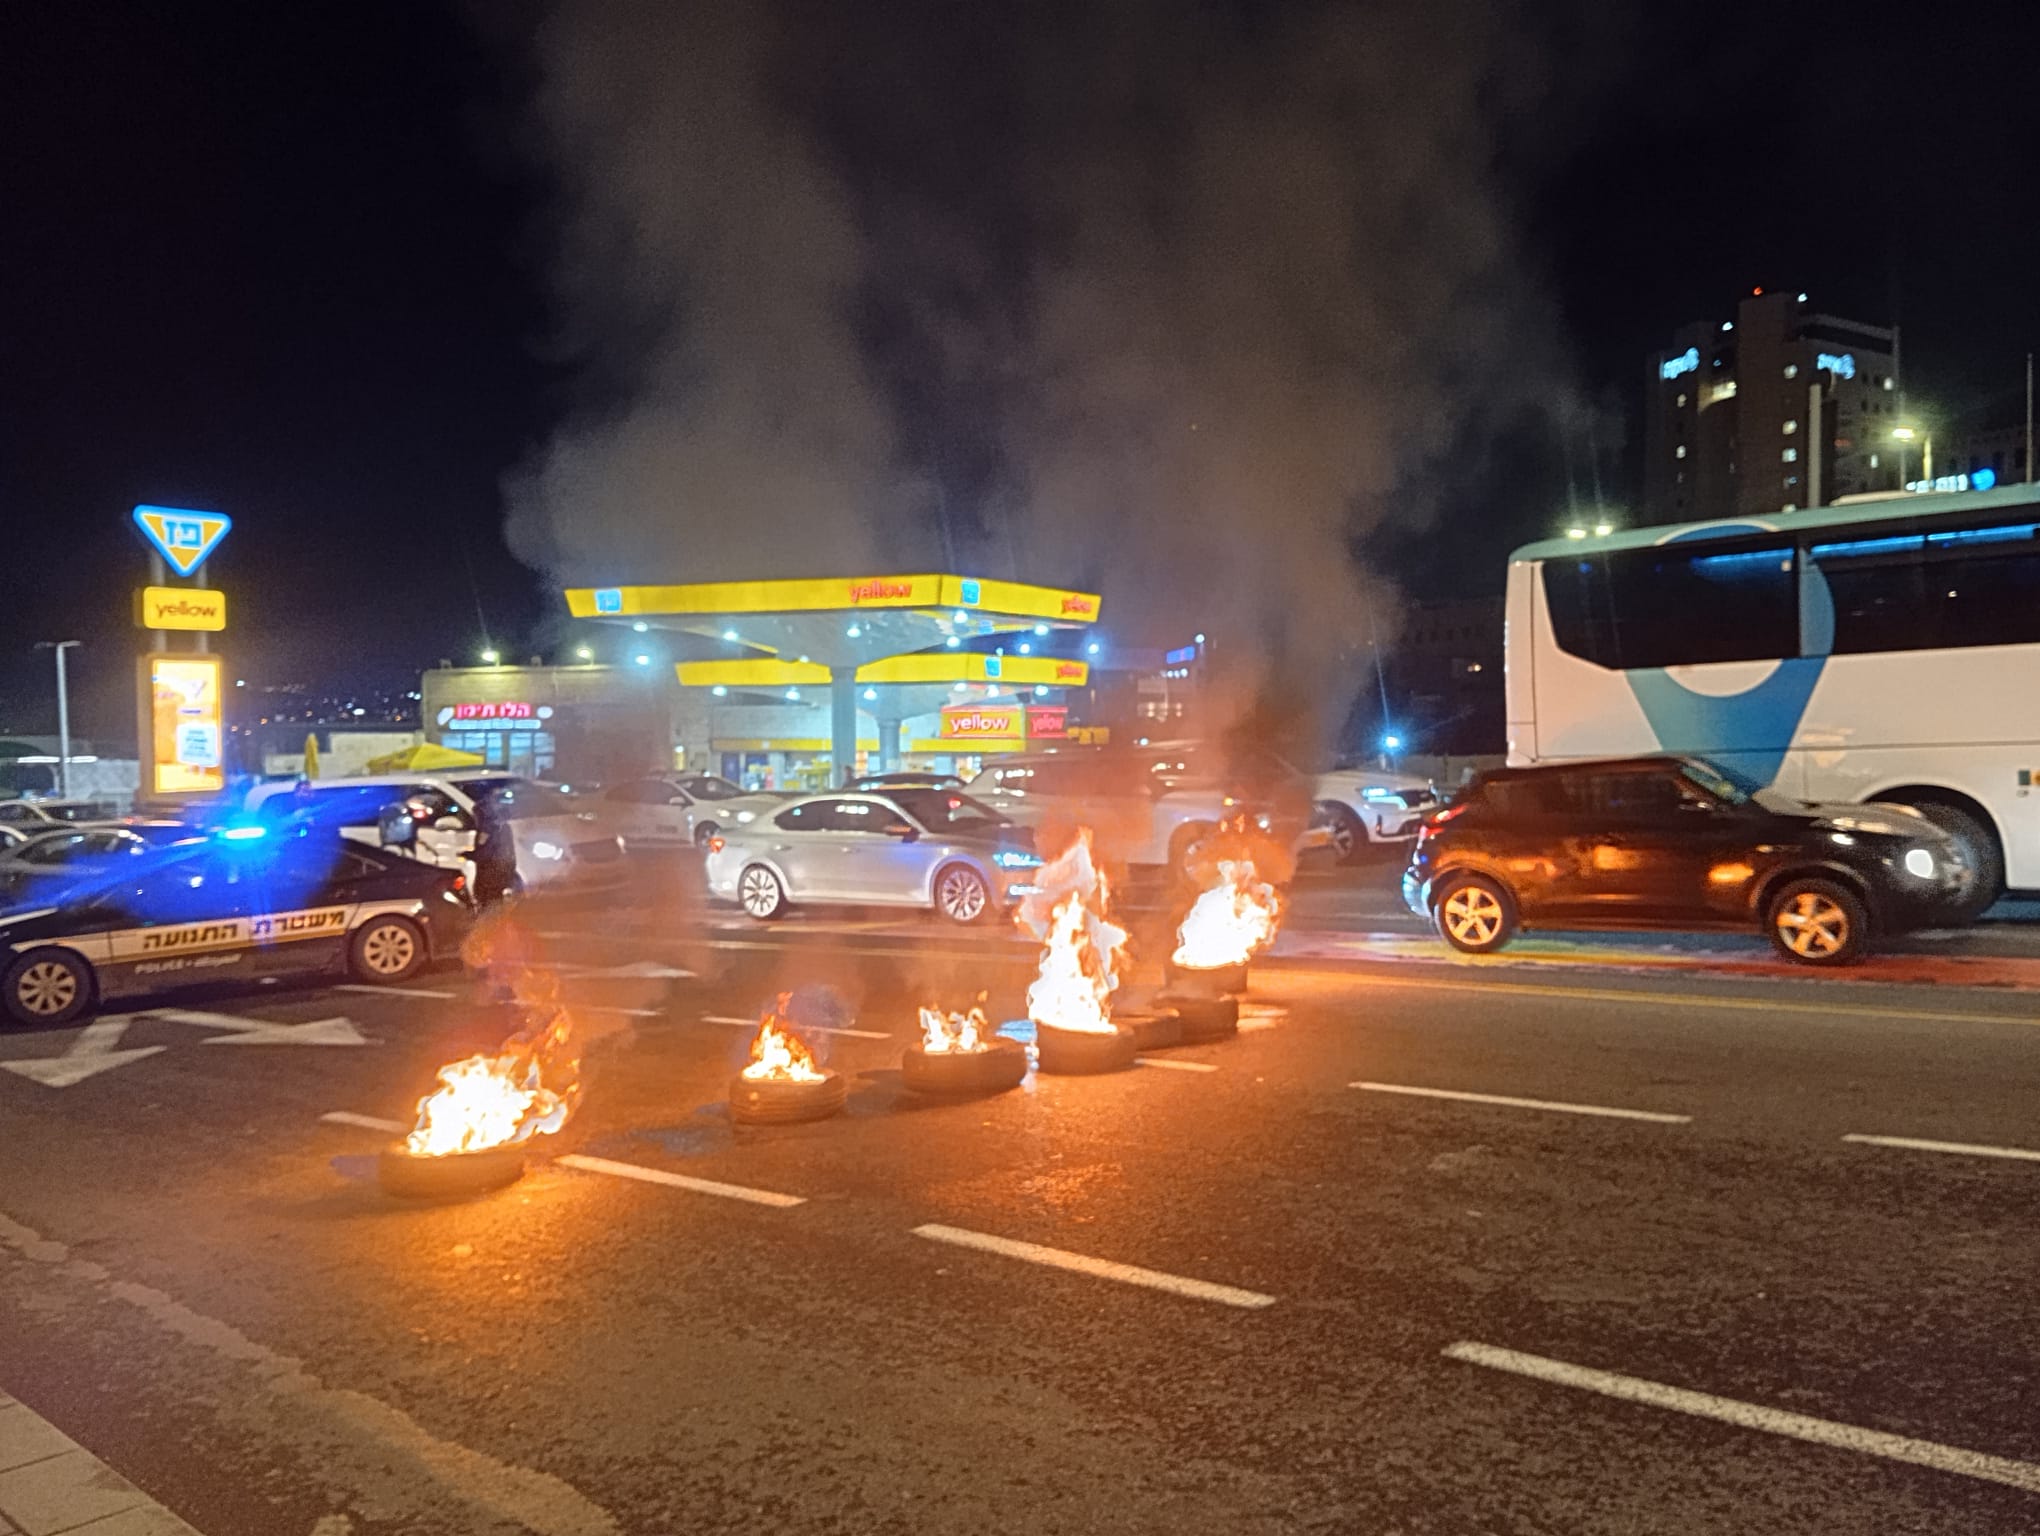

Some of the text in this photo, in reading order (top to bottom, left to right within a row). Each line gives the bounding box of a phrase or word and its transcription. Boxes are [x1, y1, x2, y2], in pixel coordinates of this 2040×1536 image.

[165, 520, 201, 547] פז
[848, 579, 912, 603] yellow
[155, 600, 217, 619] yellow
[951, 713, 1009, 732] yellow
[1031, 712, 1064, 732] yellow
[143, 910, 345, 949] משטרת התנועה
